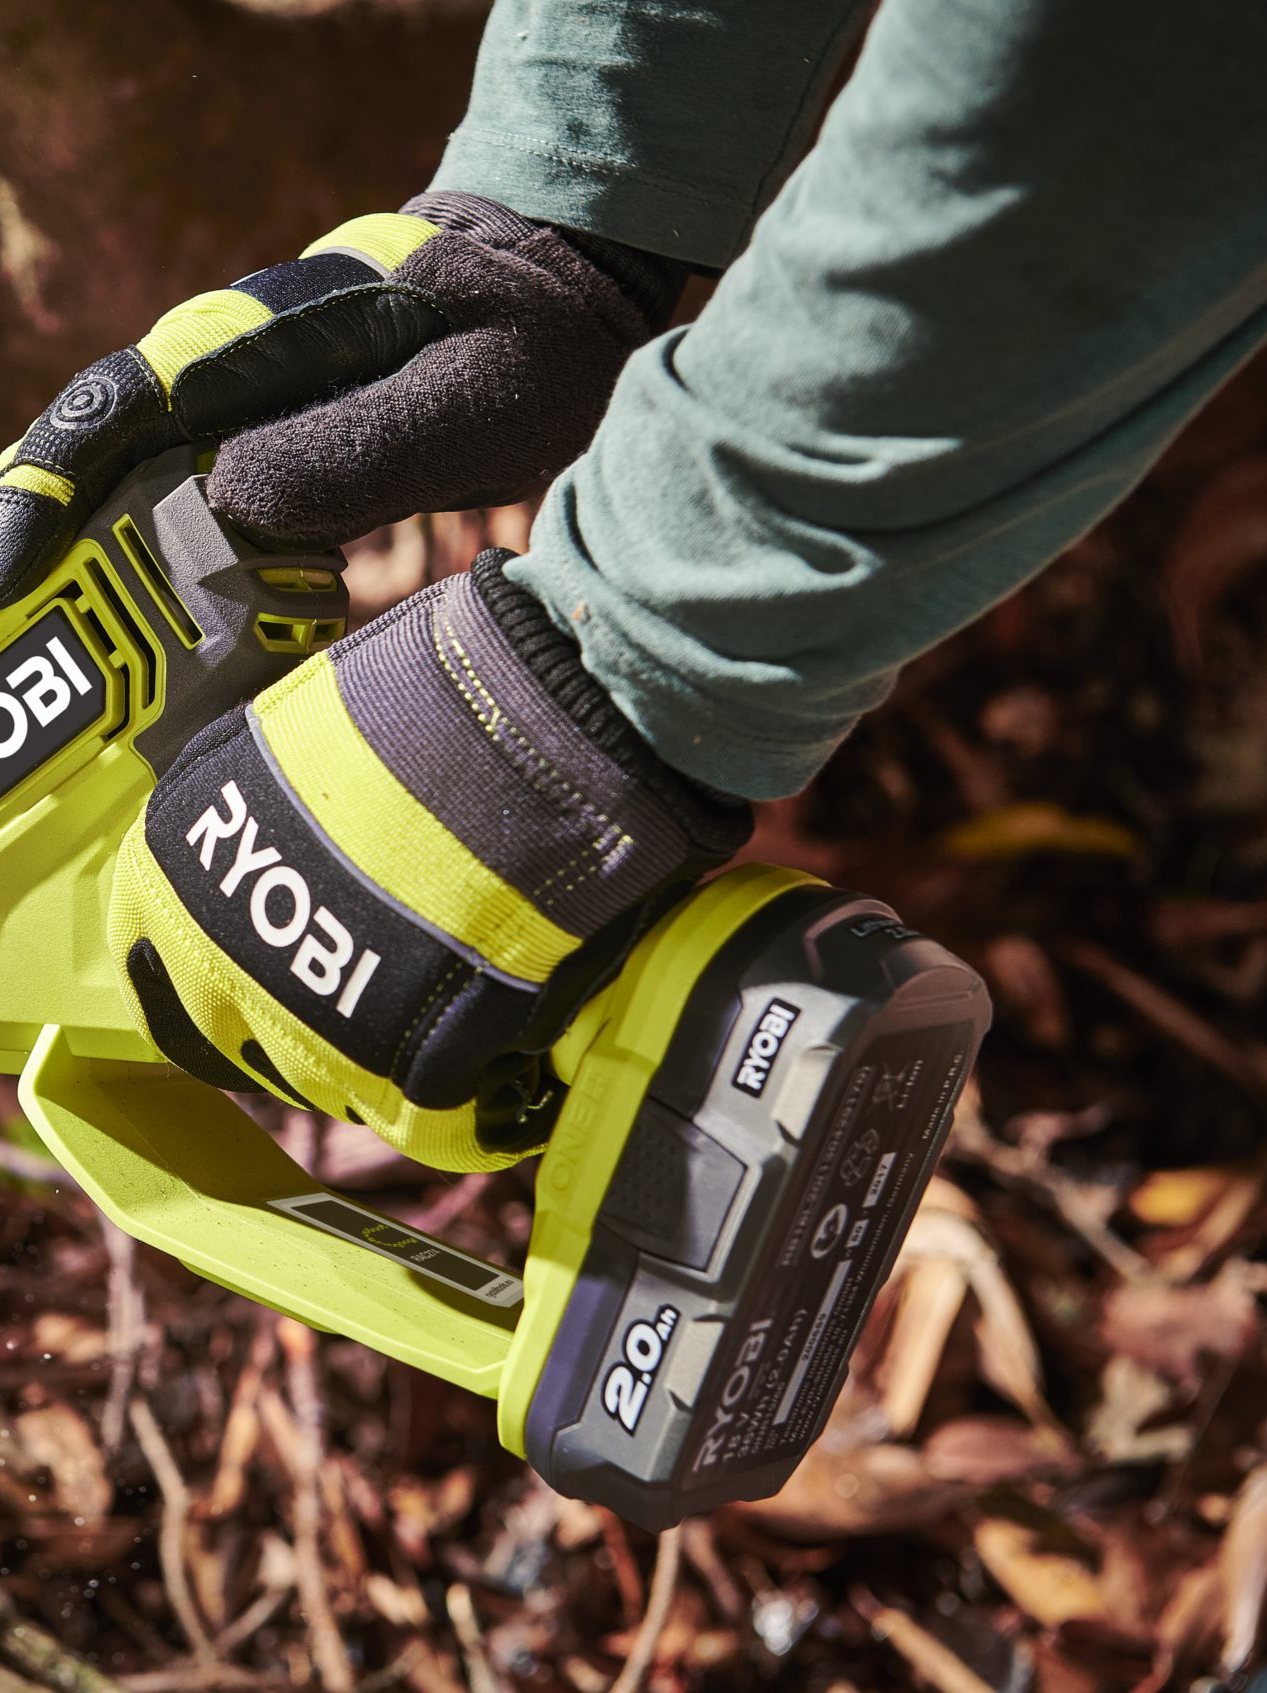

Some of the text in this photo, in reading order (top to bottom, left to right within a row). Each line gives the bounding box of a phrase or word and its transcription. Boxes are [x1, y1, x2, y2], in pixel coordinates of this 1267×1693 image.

[186, 780, 381, 1018] RYOBI
[736, 1004, 795, 1090] RYOBI
[604, 1308, 678, 1431] 2.0Ah
[693, 1318, 775, 1471] RYOBI
[764, 1307, 808, 1389] (2.0Ah)
